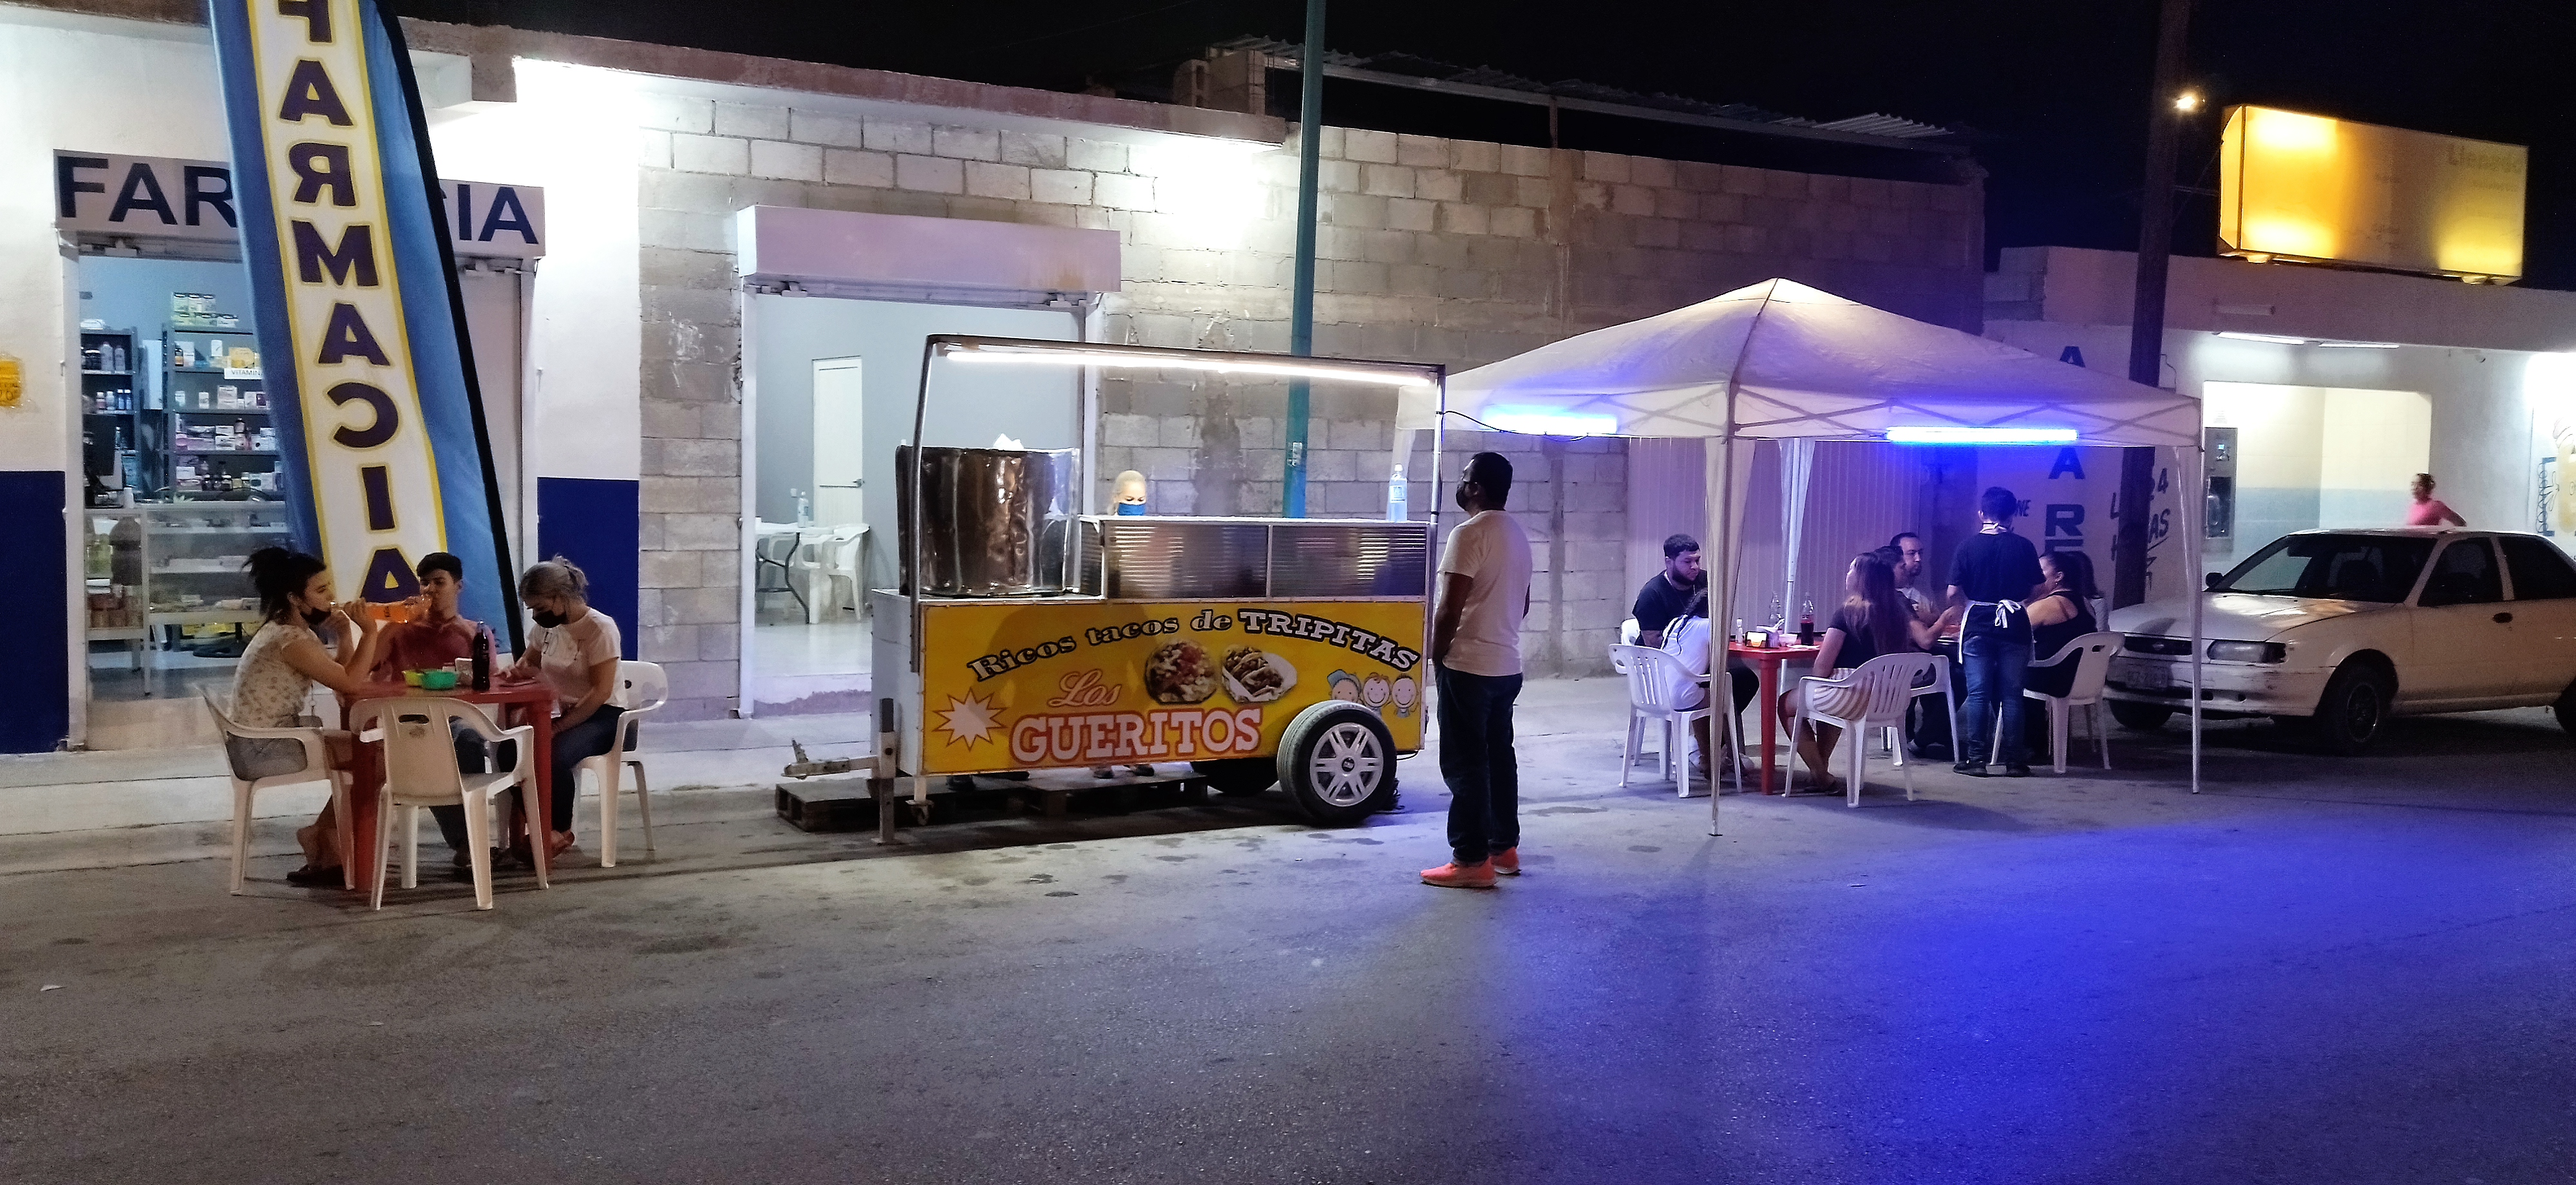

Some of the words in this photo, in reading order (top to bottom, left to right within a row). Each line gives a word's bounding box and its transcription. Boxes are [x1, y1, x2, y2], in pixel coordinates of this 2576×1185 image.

[57, 156, 538, 244] FARIA
[967, 636, 1077, 682] Ricos
[1086, 617, 1179, 646] tacos
[1191, 609, 1233, 631] de
[1239, 609, 1420, 670] TRIPITAS
[1048, 668, 1123, 708] Los
[1010, 706, 1262, 764] GUERITOS
